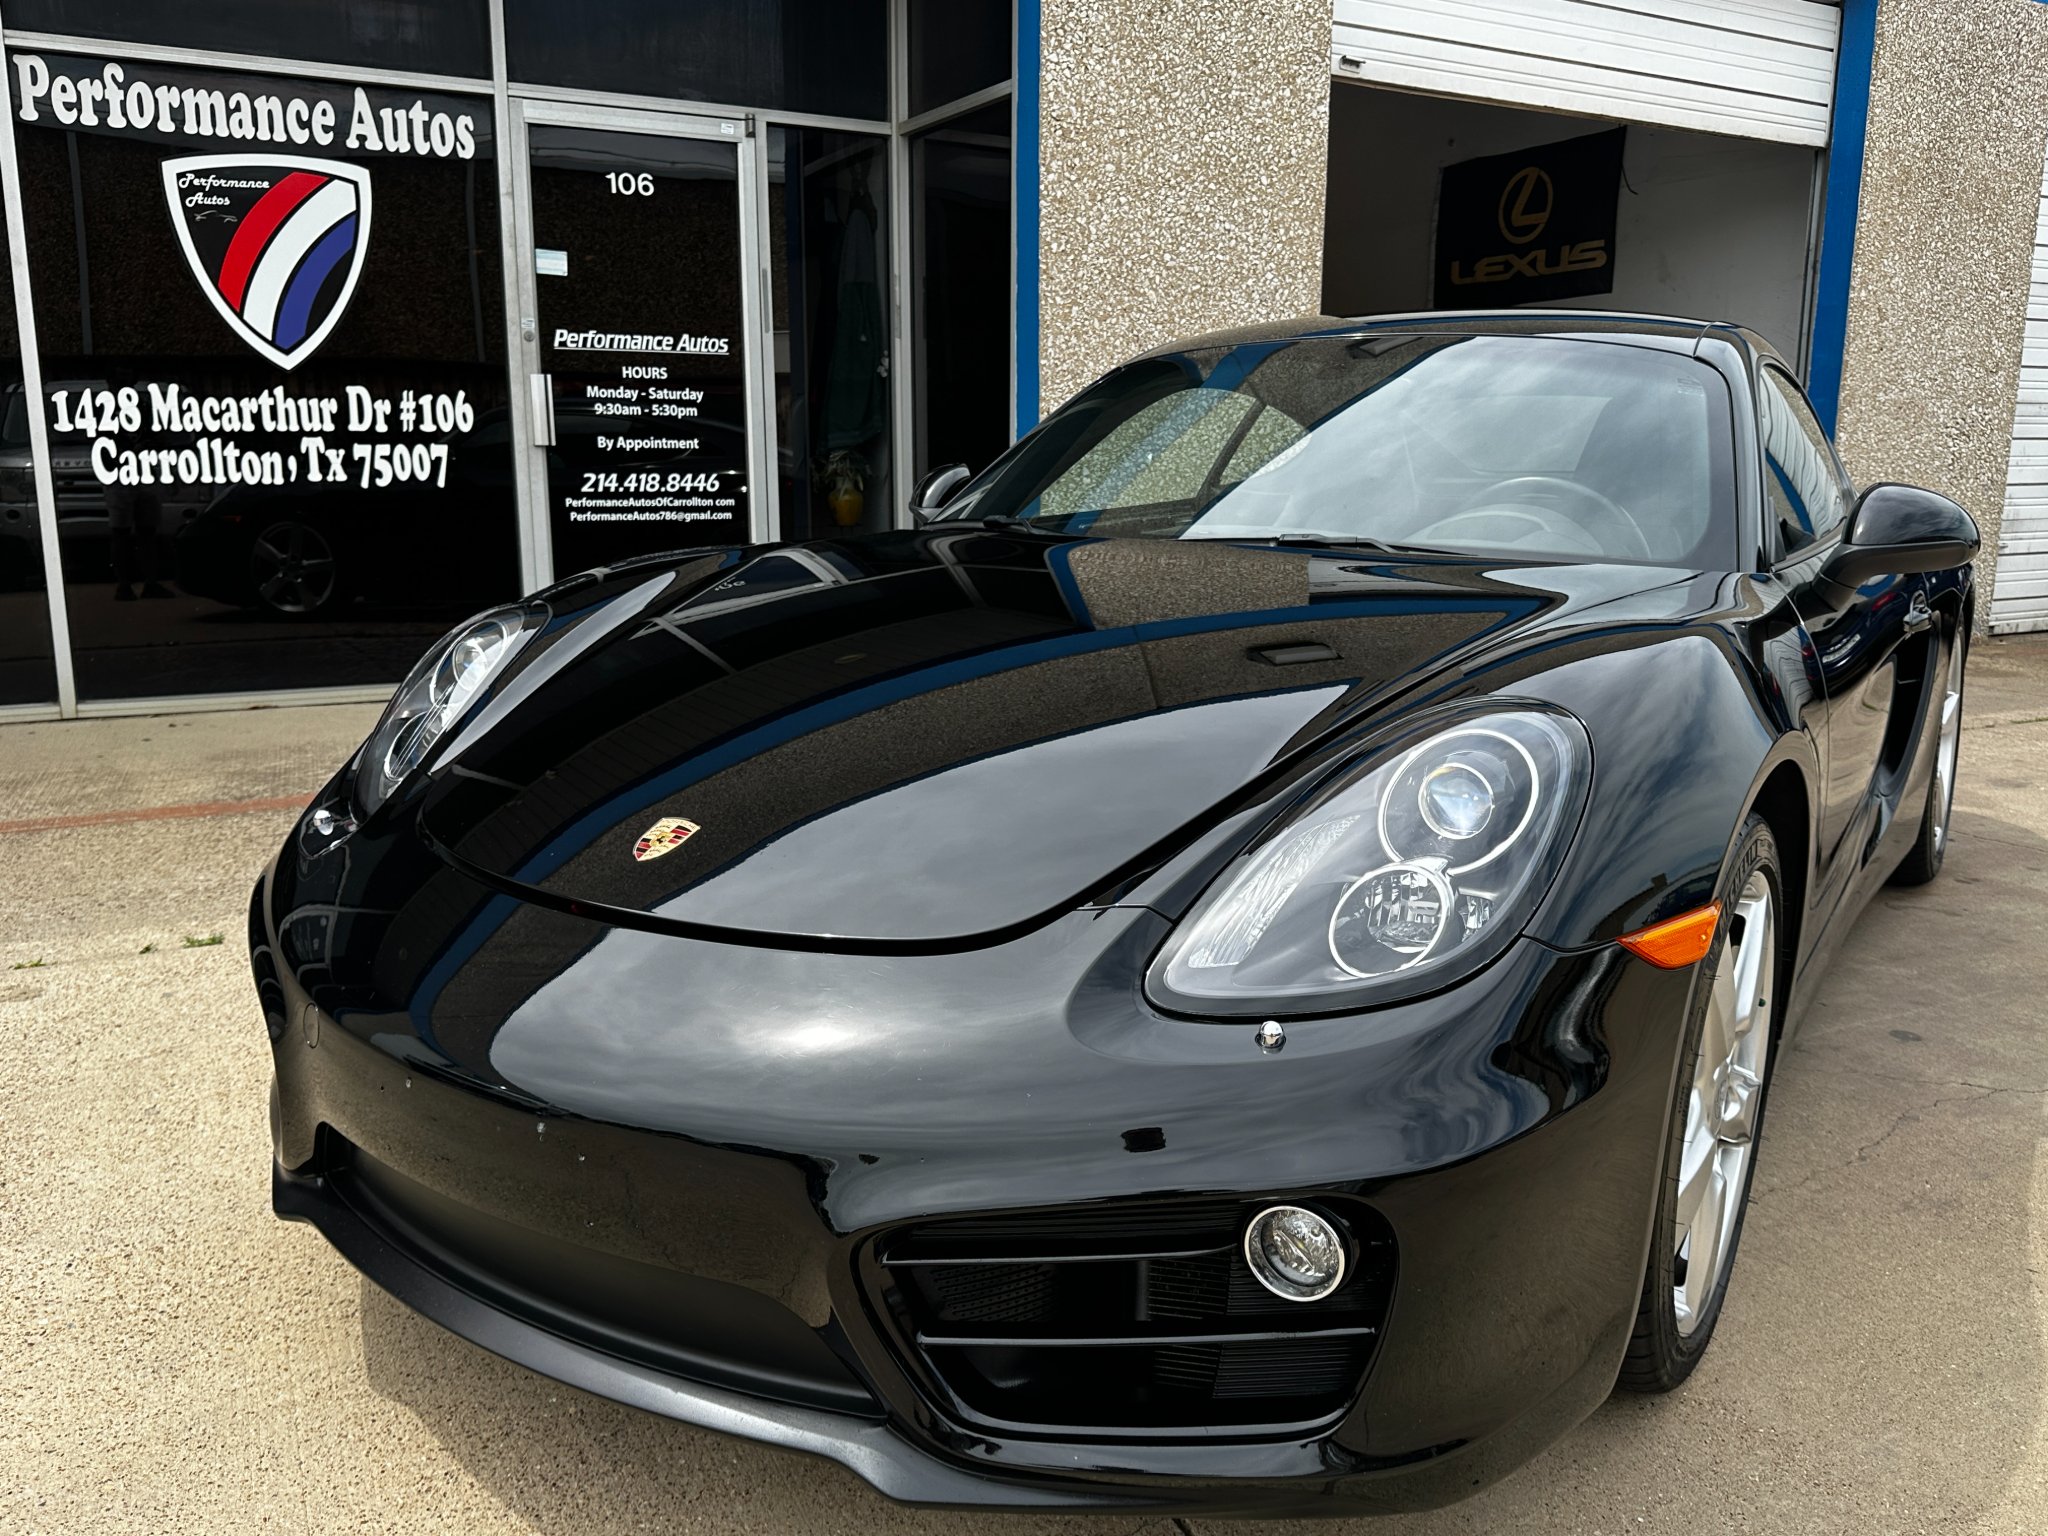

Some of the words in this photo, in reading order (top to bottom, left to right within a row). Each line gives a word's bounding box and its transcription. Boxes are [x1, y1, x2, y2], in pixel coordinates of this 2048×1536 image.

[13, 55, 335, 146] Performance
[346, 87, 475, 159] Autos
[179, 172, 270, 192] Performance
[605, 171, 655, 196] 106
[185, 191, 231, 208] Autos
[1451, 240, 1607, 285] LEXUS
[553, 329, 674, 351] Performance
[676, 333, 729, 353] Autos
[621, 366, 668, 380] HOURS
[586, 385, 639, 402] Monday
[648, 387, 704, 403] Saturday
[51, 386, 142, 438] 1428
[147, 383, 338, 433] Macarthur
[345, 385, 392, 433] Dr
[400, 389, 474, 433] #106
[594, 402, 642, 416] 9:30am
[651, 404, 698, 419] 5:30pm
[597, 435, 614, 451] By
[616, 436, 700, 451] Appointment
[91, 437, 297, 486] Carrollton,
[301, 436, 347, 483] Tx
[353, 443, 449, 489] 75007
[581, 473, 720, 493] 214.418.8446
[565, 497, 736, 508] PerformanceAutosOfCarrolltoncom
[570, 510, 733, 523] PerformanceAutos786@gmail.com
